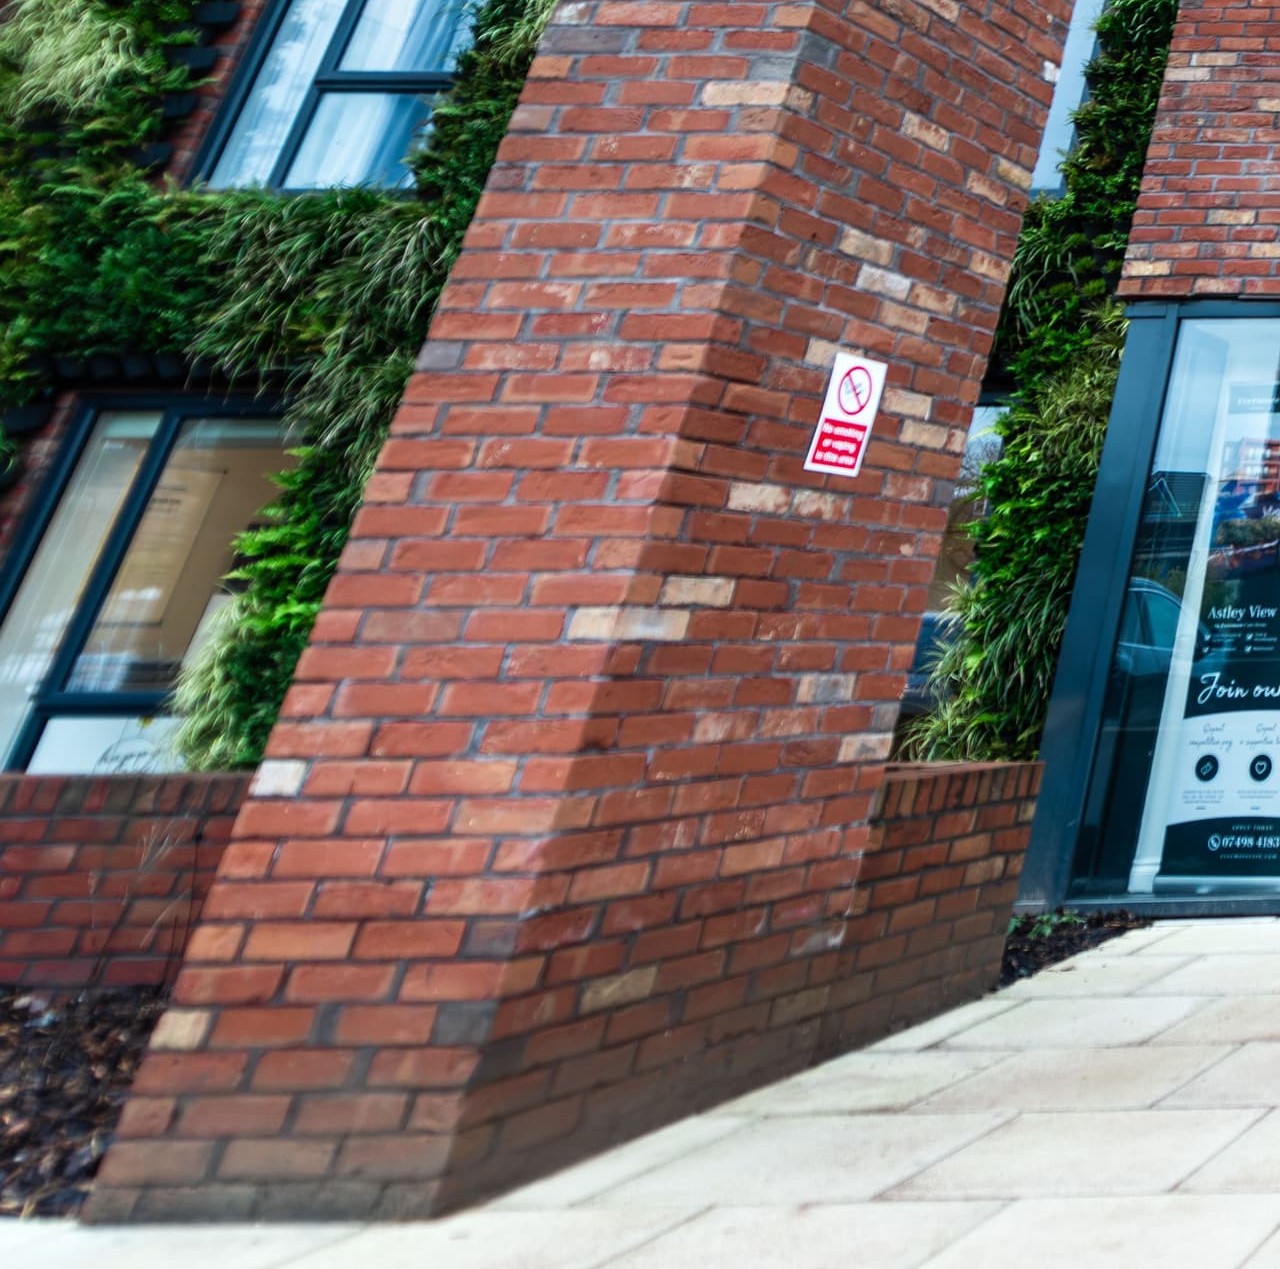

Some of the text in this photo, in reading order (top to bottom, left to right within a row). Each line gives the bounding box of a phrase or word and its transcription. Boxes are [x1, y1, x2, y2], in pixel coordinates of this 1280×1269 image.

[1207, 605, 1278, 621] Astley View
[1197, 671, 1249, 705] Join
[1221, 835, 1255, 849] 07498
